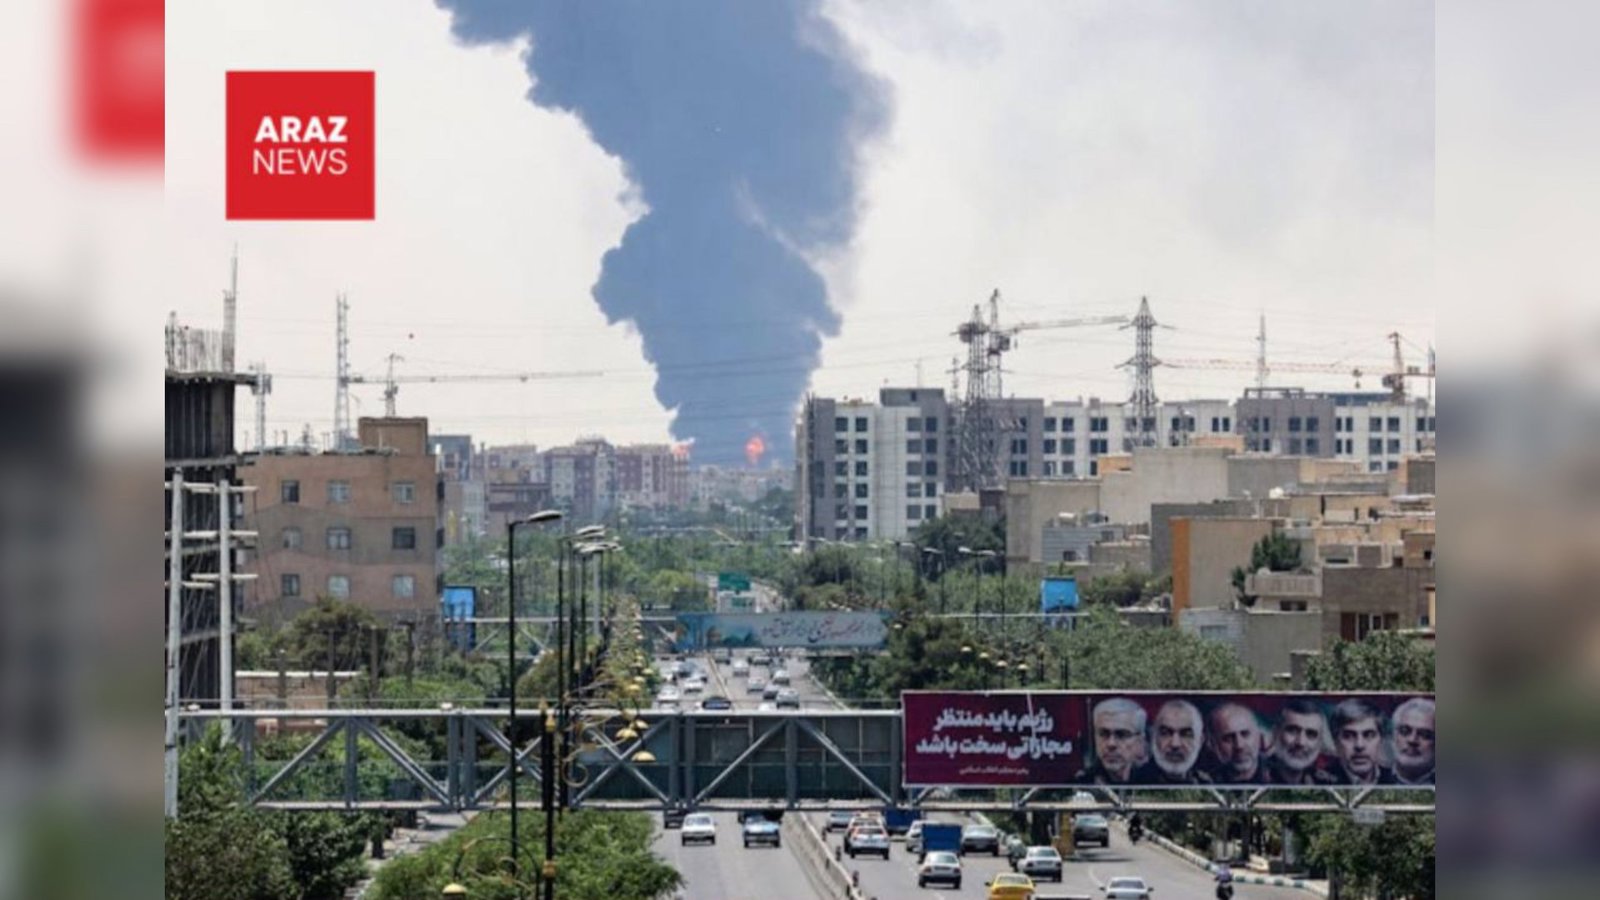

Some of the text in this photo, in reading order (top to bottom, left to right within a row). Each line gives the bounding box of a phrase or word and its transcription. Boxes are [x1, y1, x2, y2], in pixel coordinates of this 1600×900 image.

[933, 707, 1054, 732] رژیم باید منتظر
[915, 733, 1073, 760] مجازاتی سخت باشد
